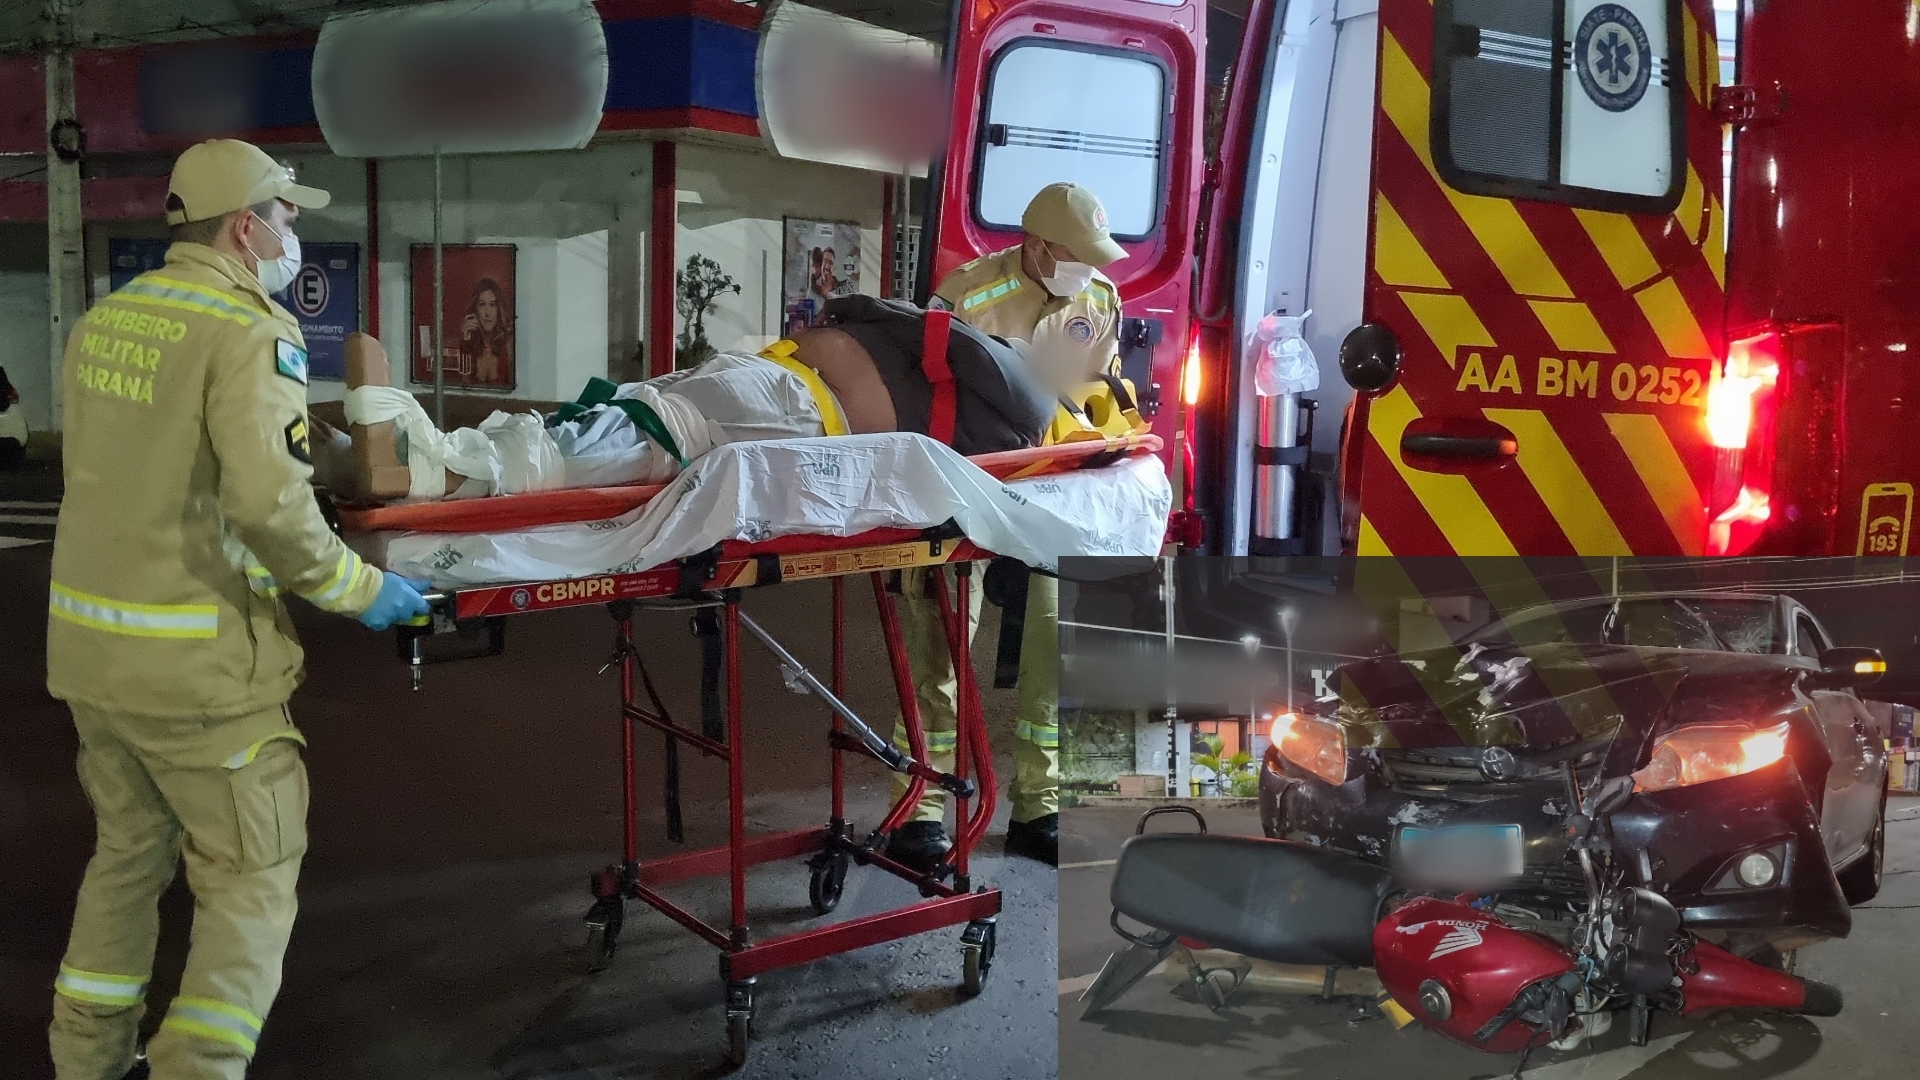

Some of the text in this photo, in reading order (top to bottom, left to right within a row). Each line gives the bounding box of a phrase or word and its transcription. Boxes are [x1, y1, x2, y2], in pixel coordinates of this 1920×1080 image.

[303, 275, 319, 305] E
[80, 333, 161, 372] MILITAR
[77, 363, 154, 405] PARANÁ
[1456, 352, 1704, 408] AA BM 0252
[1869, 533, 1898, 553] 193
[536, 577, 615, 603] CBMPR
[1436, 919, 1490, 932] HONDA
